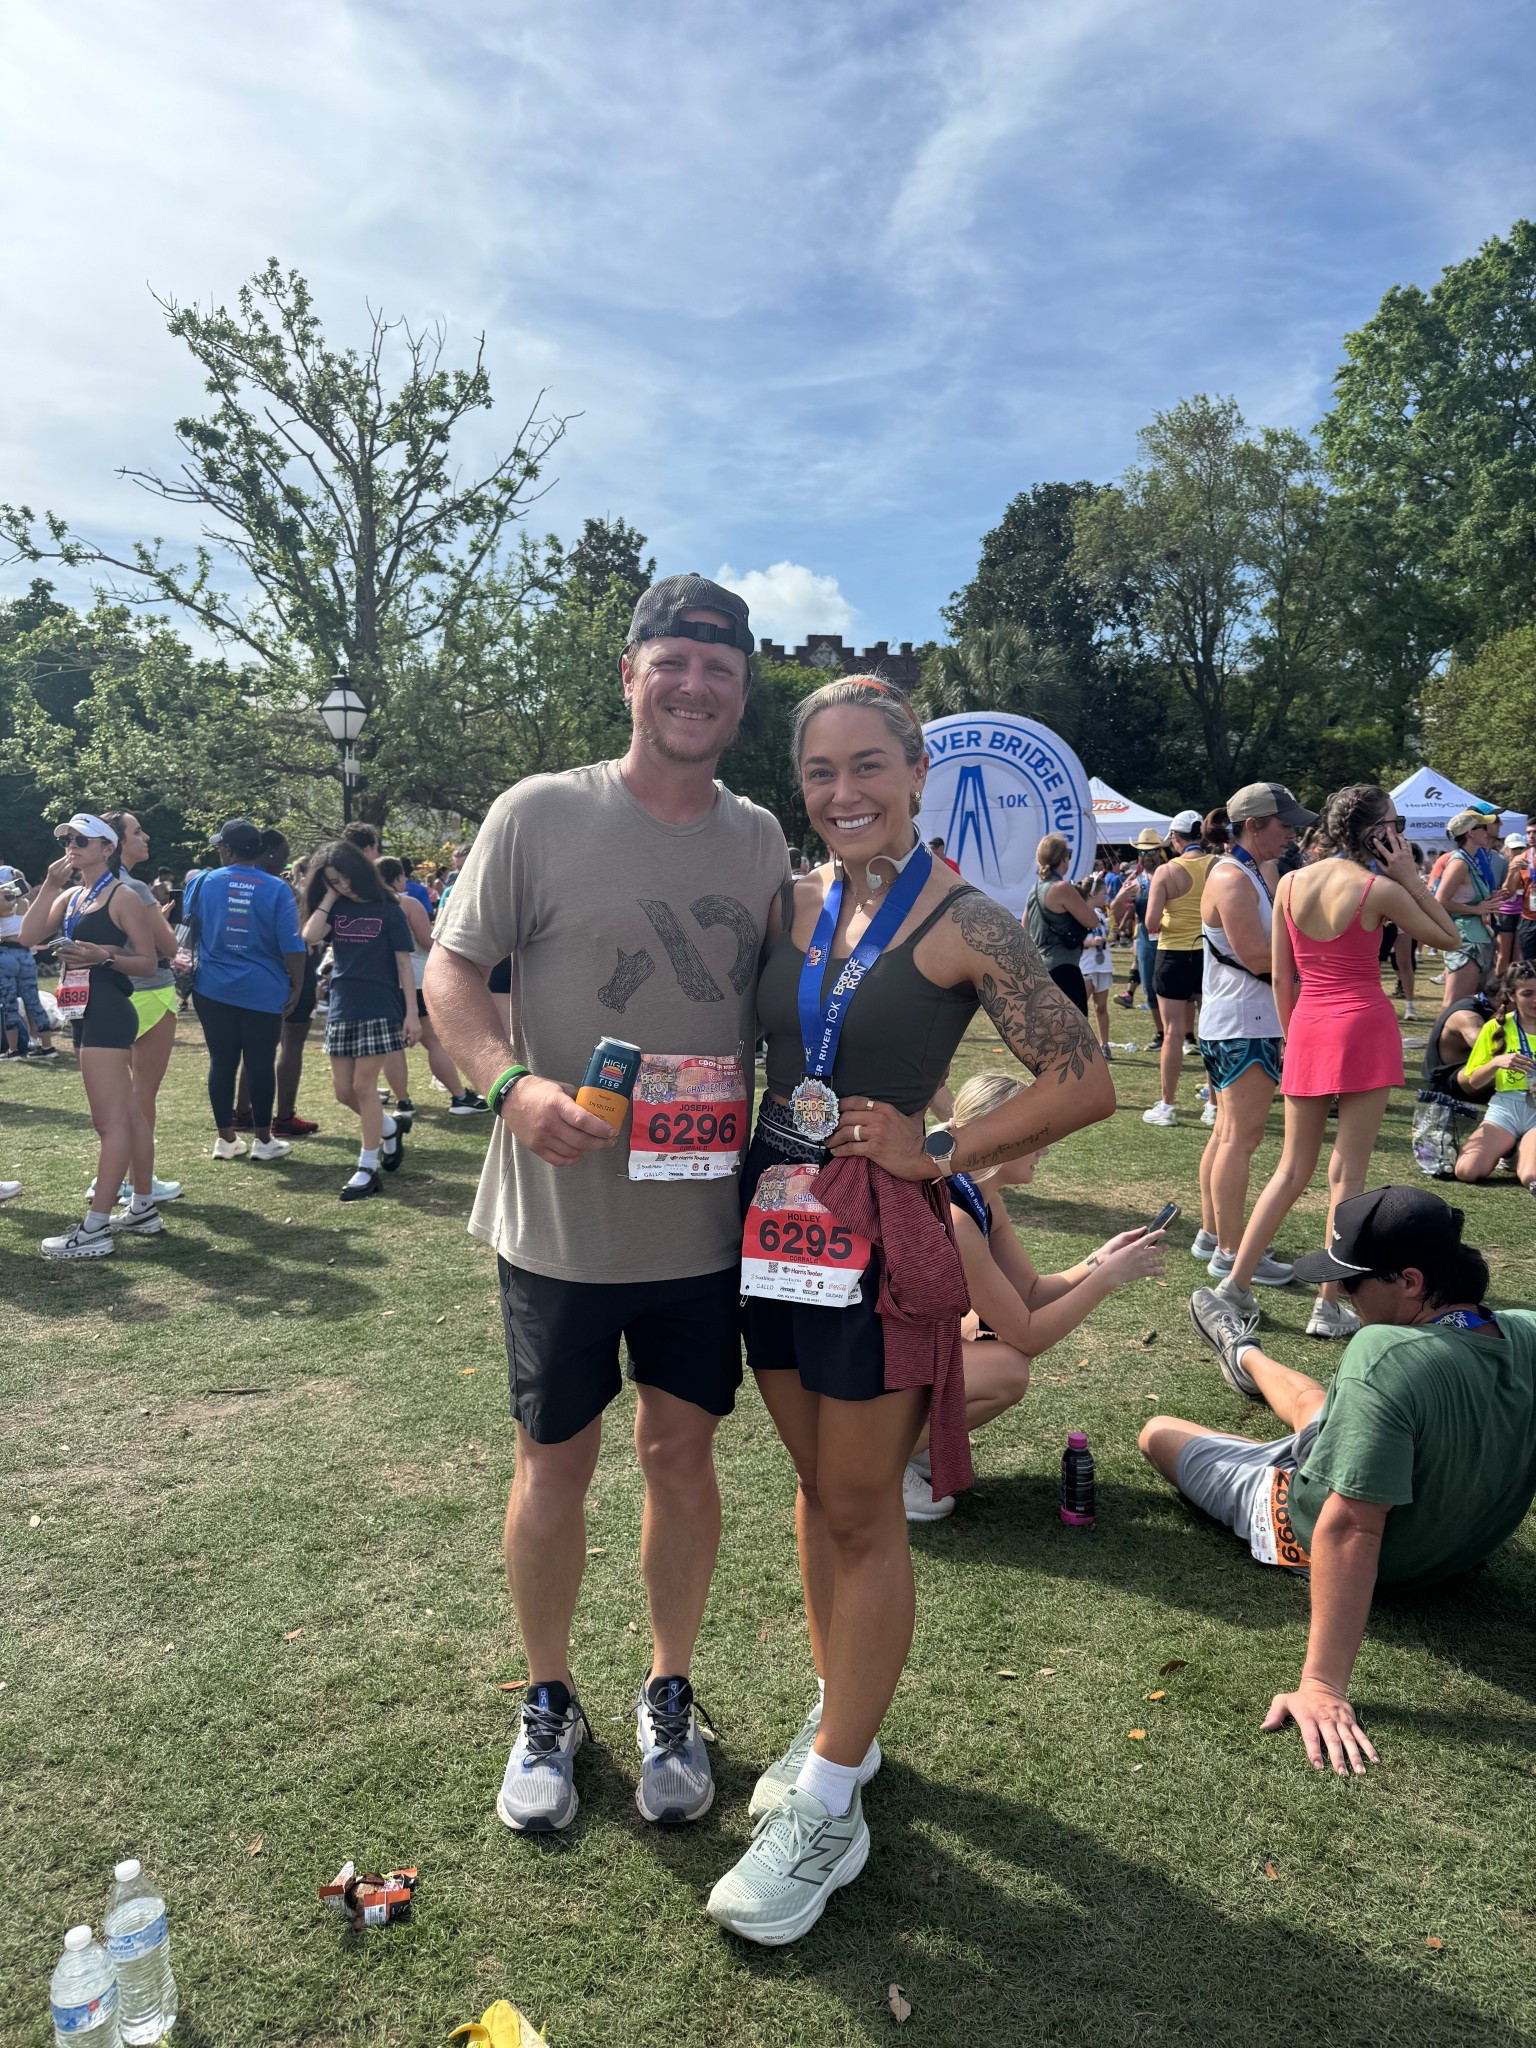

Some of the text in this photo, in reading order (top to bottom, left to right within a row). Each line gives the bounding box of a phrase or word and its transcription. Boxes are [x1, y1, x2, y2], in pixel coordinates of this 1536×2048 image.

[988, 731, 1064, 792] BRIDGE
[998, 794, 1029, 808] 10K
[229, 881, 255, 890] GILDAN
[833, 957, 860, 996] BRIDGE
[846, 965, 867, 991] RUN
[825, 1001, 842, 1024] 10K
[818, 1027, 833, 1062] RIVER
[602, 1057, 628, 1075] HIGH
[599, 1078, 620, 1089] rise
[640, 1073, 674, 1084] BRIDGE
[648, 1082, 670, 1094] RUN
[679, 1104, 713, 1112] JOSEPH
[795, 1099, 831, 1112] BRIDGE
[803, 1111, 826, 1122] RUN
[648, 1112, 737, 1145] 6296
[760, 1181, 785, 1191] BRIDGE
[763, 1190, 780, 1200] RUN
[956, 1173, 986, 1217] COOPER RIVER
[787, 1213, 821, 1223] HOLLEY
[759, 1219, 853, 1260] 6295
[789, 1255, 813, 1264] CORRAL
[790, 1268, 807, 1276] Harris
[756, 1283, 774, 1291] GALLO
